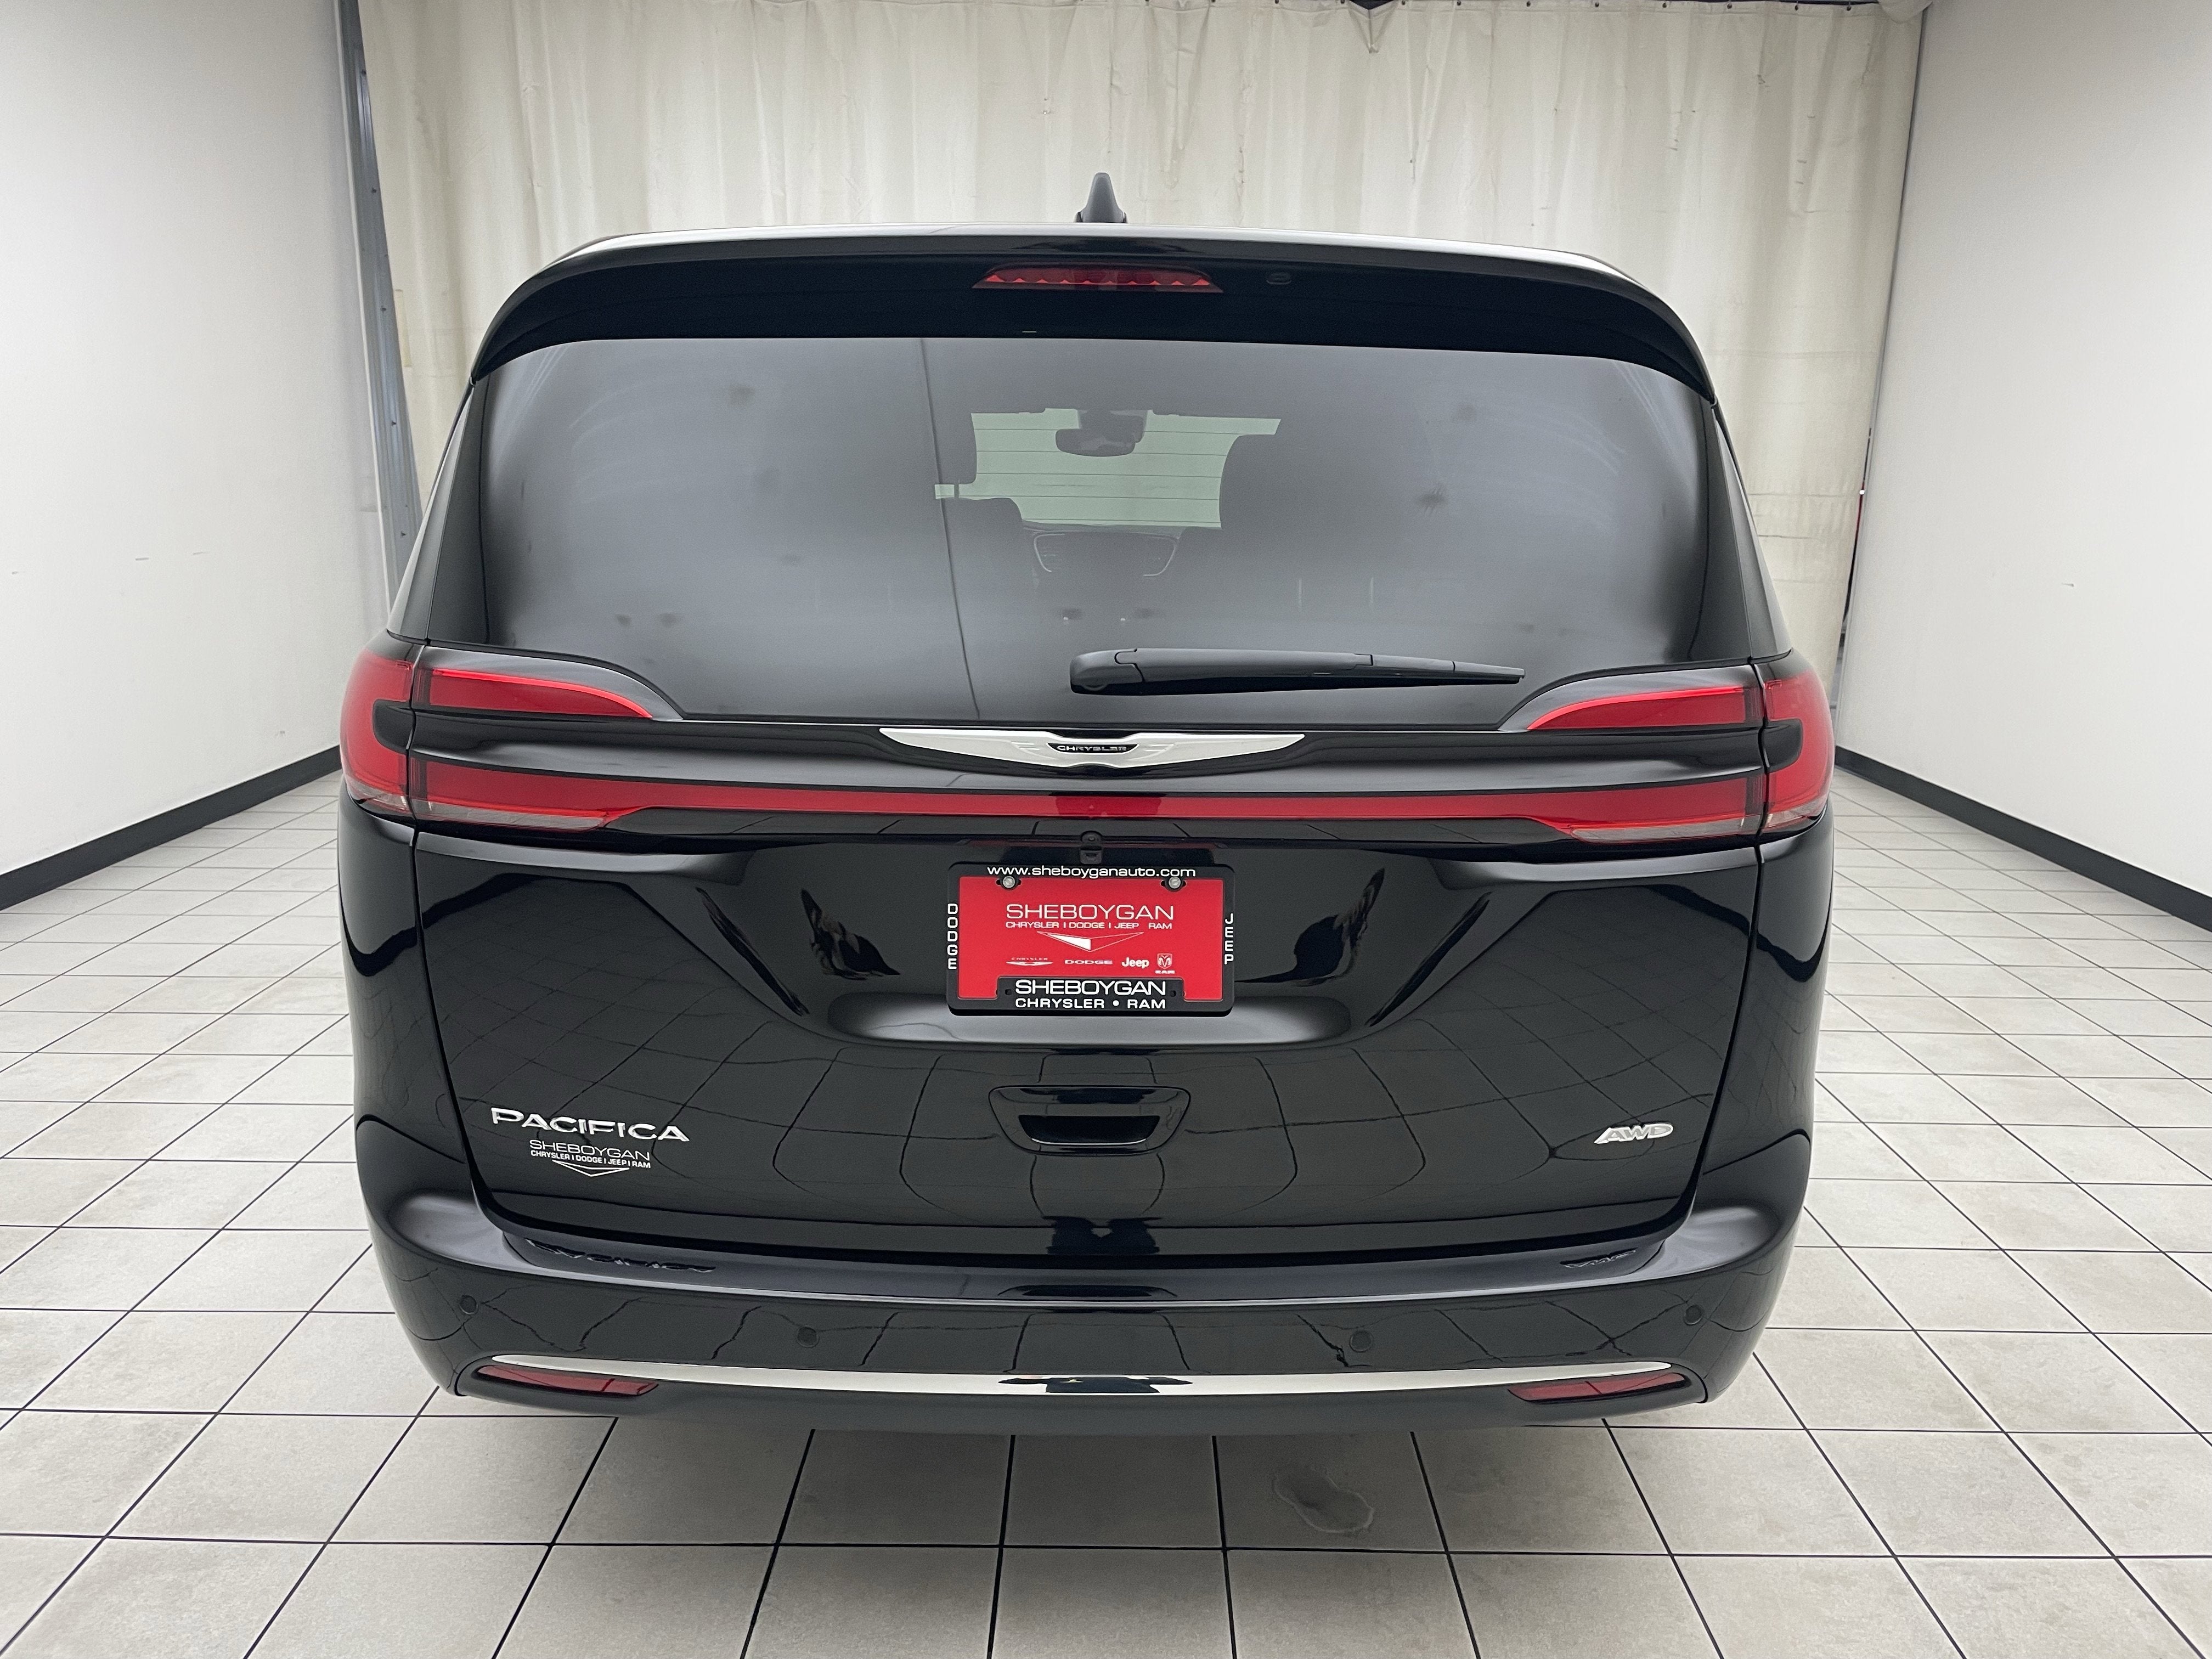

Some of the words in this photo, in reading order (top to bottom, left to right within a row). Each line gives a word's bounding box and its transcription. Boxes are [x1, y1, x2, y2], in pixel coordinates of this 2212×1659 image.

[987, 866, 1195, 878] www.sheboyganauto.com
[1006, 904, 1173, 920] SHEBOYGAN
[947, 903, 958, 969] DODGE
[1224, 913, 1233, 965] JEEP
[1121, 957, 1149, 969] Jeep
[1015, 979, 1166, 996] SHEBOYGAN
[1015, 998, 1104, 1009] CHRYSLER
[1127, 998, 1166, 1009] RAM
[491, 1108, 690, 1142] PACIFICA
[1594, 1123, 1673, 1144] AWD
[529, 1139, 650, 1161] SHEBOYGAN
[530, 1150, 570, 1160] CHRYSLER
[575, 1154, 602, 1164] DODGE
[607, 1158, 627, 1166] JEEP
